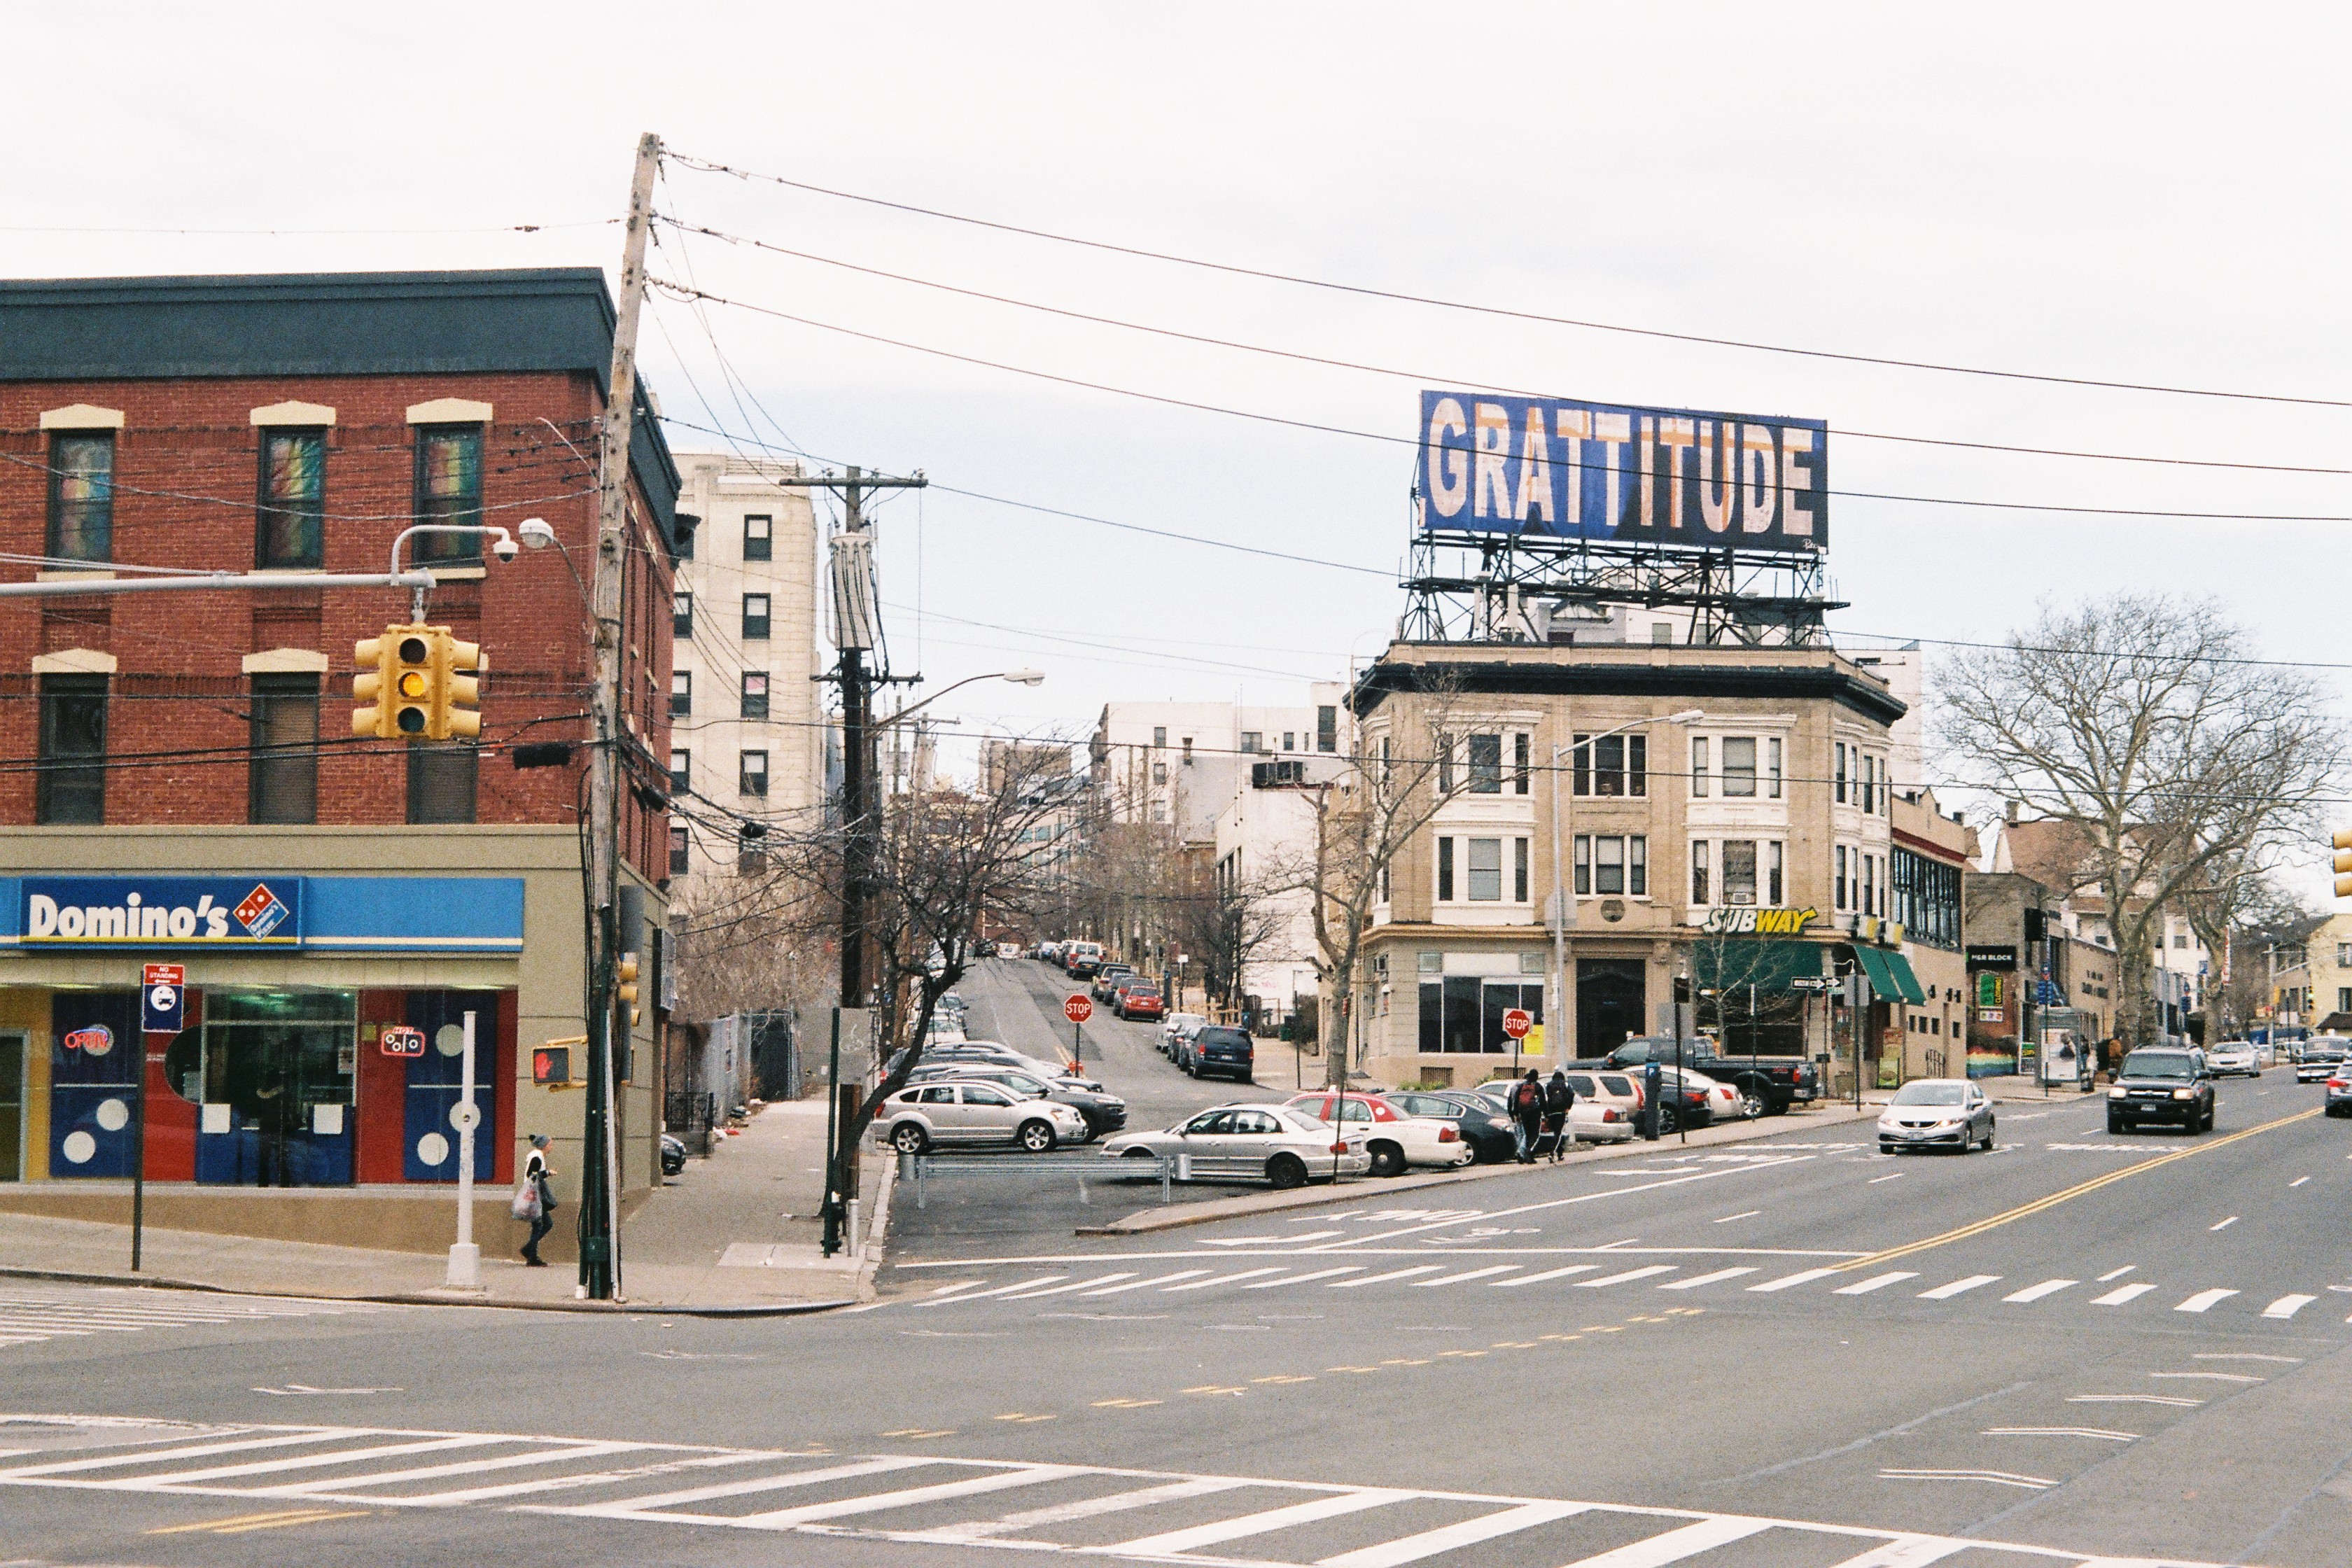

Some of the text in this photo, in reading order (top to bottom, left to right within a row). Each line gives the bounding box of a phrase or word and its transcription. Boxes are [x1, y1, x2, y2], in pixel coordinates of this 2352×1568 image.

[1428, 398, 1814, 536] GRATTITUDE
[29, 892, 229, 937] Domino's
[1702, 909, 1816, 932] SUBWAY
[1066, 1003, 1091, 1014] STOP
[393, 1026, 414, 1035] HOT
[1506, 1018, 1529, 1030] STOP
[65, 1032, 107, 1049] OPEN
